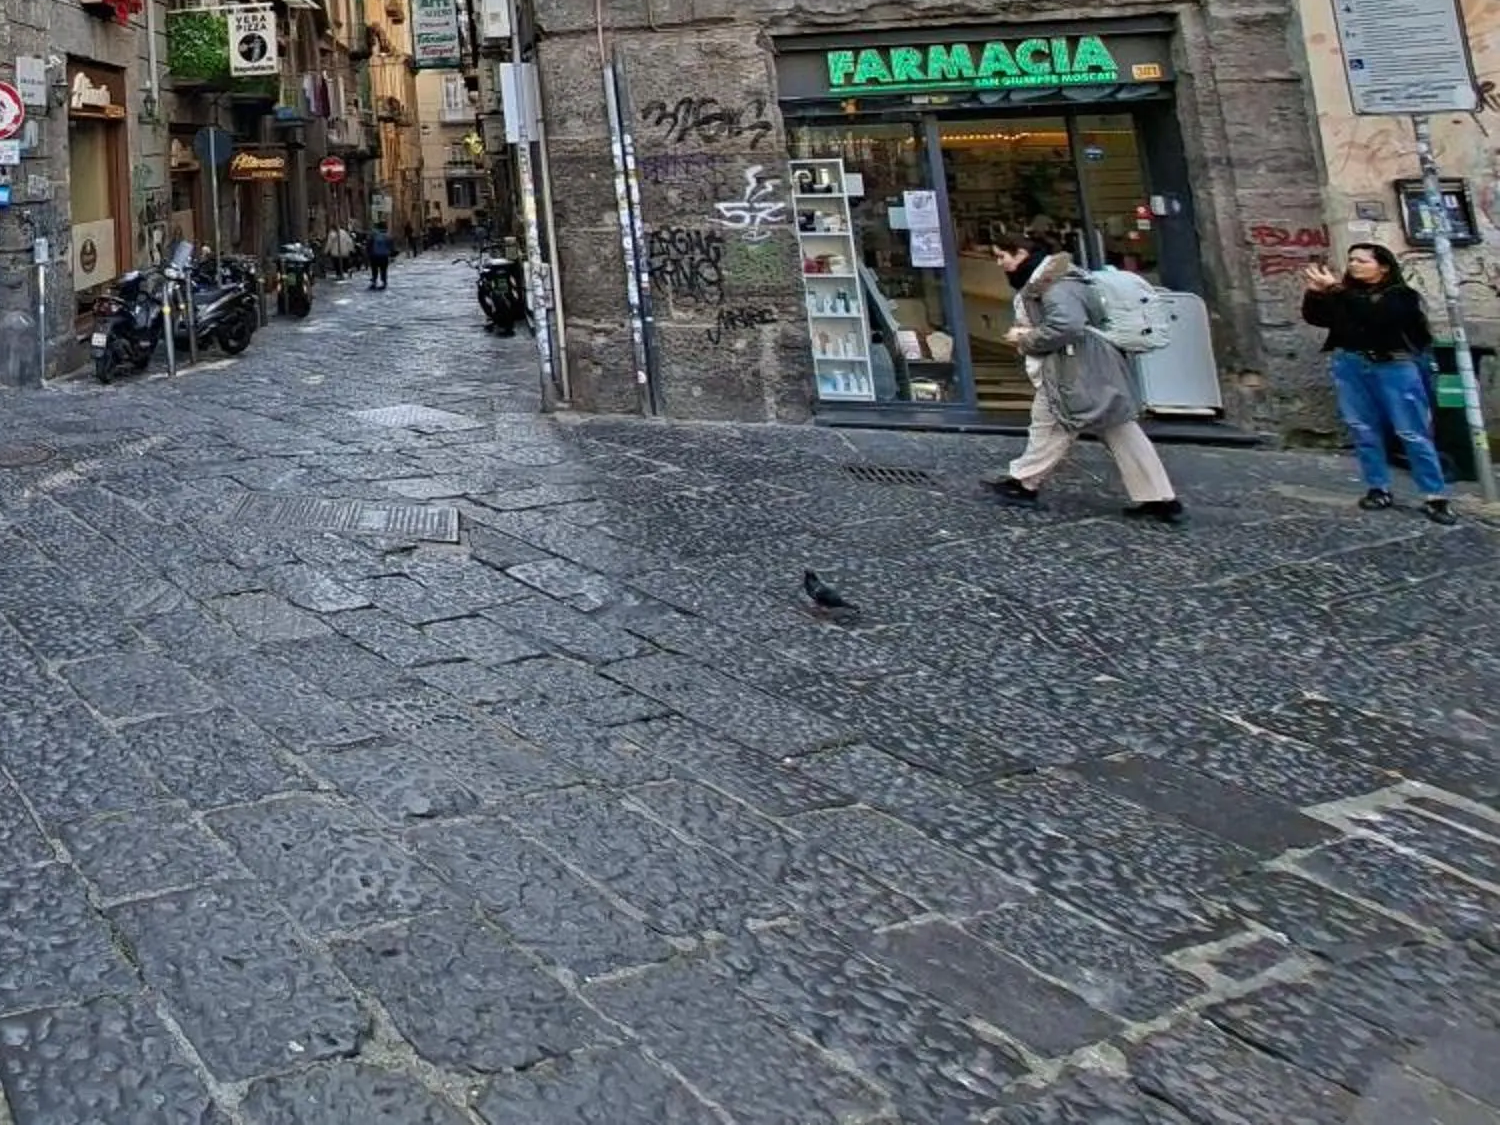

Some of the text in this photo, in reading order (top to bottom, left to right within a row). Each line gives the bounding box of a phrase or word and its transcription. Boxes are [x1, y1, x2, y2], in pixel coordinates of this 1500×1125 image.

[236, 13, 268, 23] VERA
[236, 24, 268, 32] PIZZA
[826, 35, 1118, 85] FARMACIA
[975, 77, 1000, 87] SAN
[1001, 74, 1059, 86] GIUSEPPE
